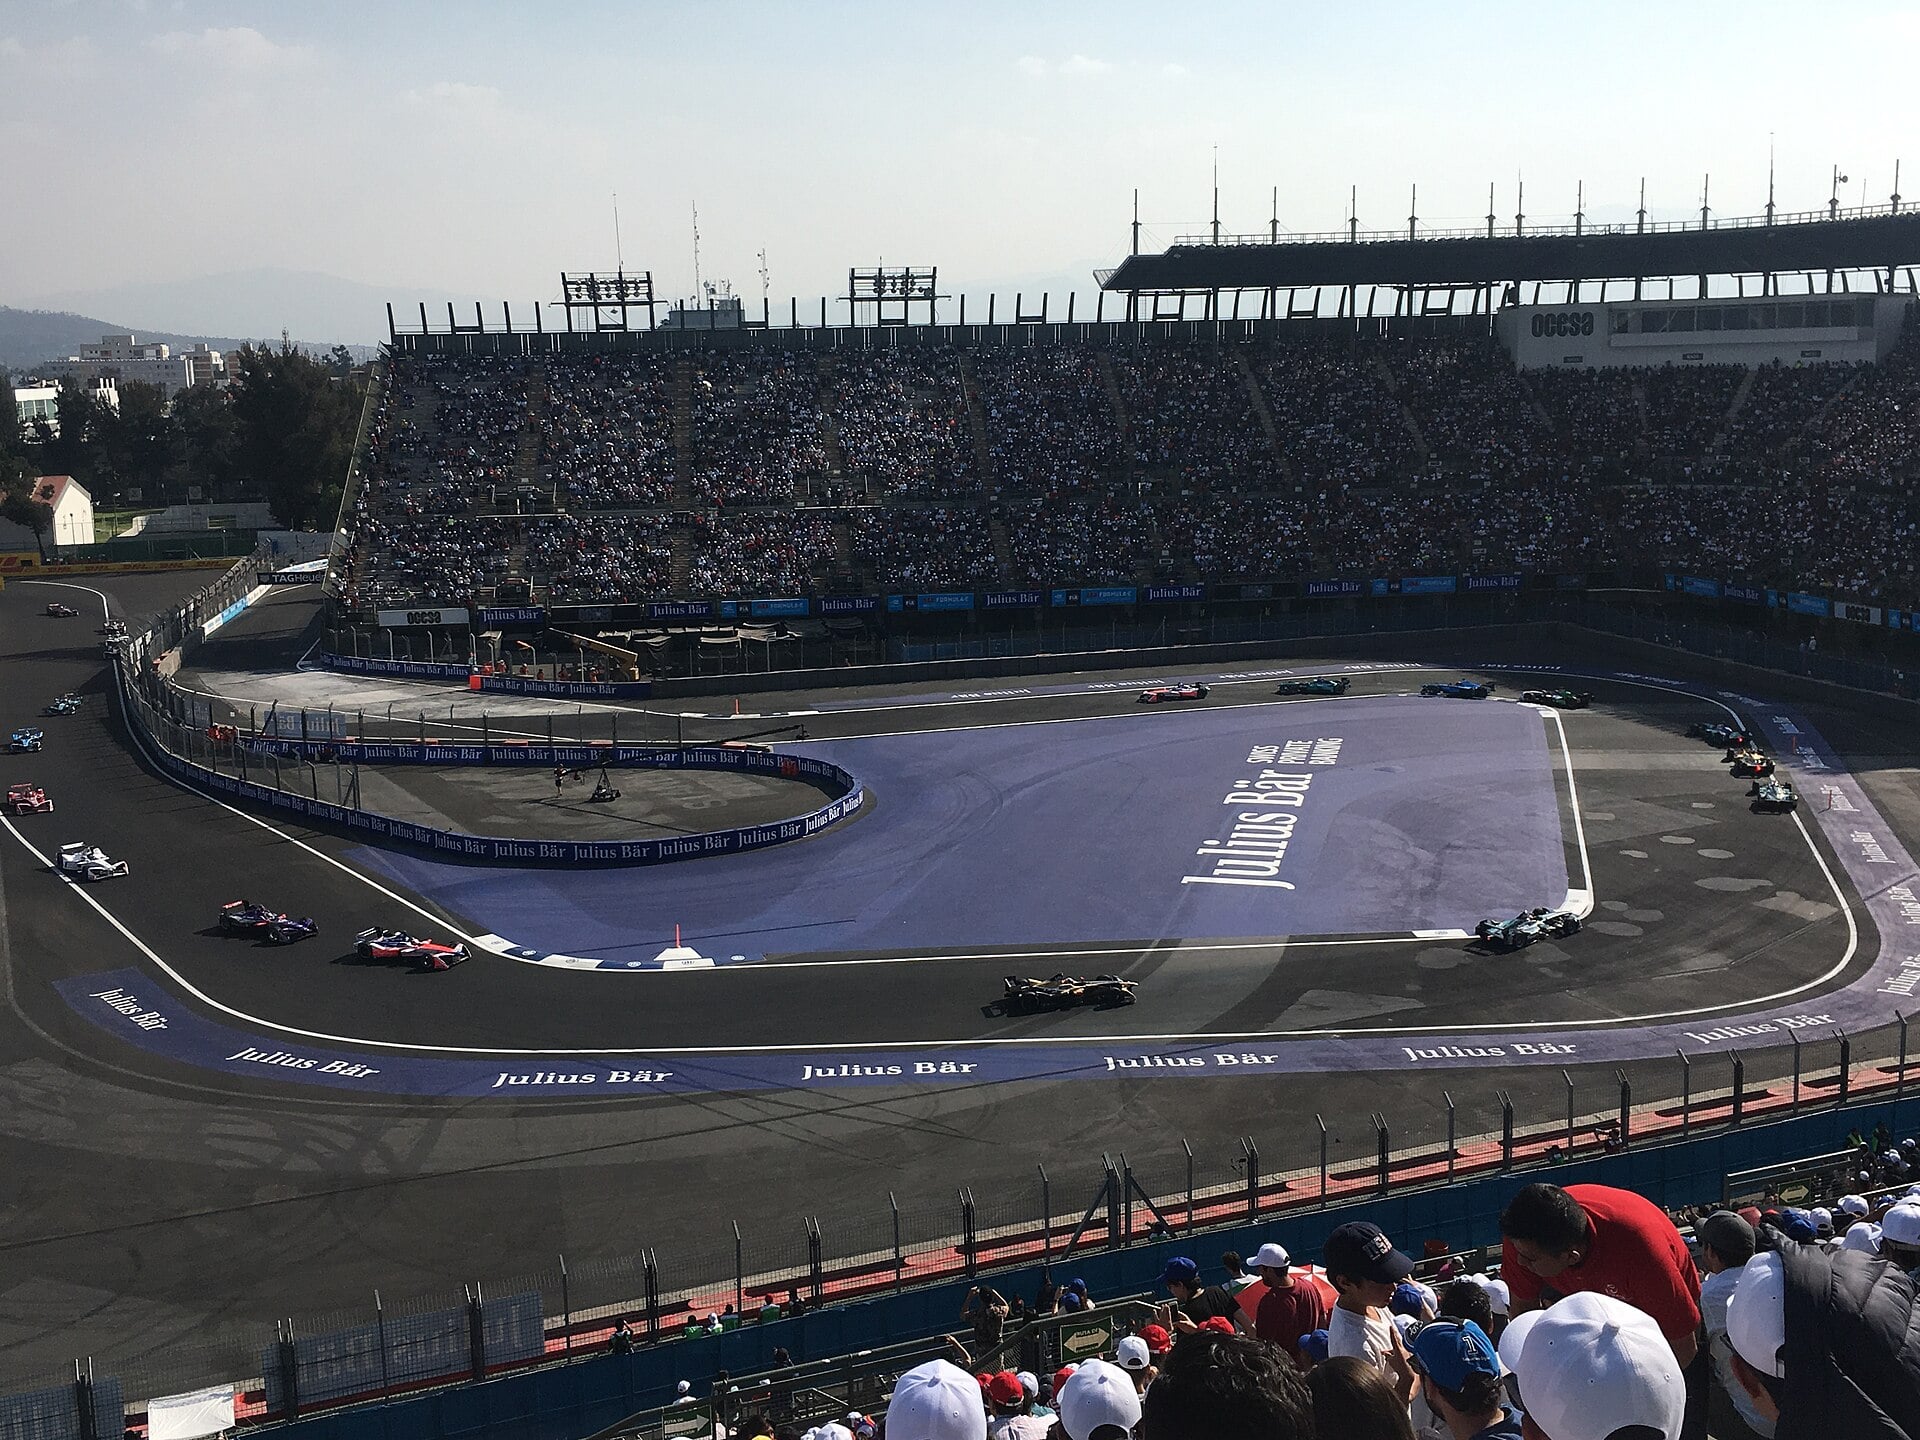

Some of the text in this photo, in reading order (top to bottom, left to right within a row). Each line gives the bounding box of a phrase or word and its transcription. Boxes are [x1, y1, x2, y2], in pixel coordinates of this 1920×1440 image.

[1309, 582, 1340, 594] Julius
[1342, 581, 1361, 593] Bär
[1468, 576, 1521, 589] Julius Bär
[986, 593, 1040, 606] Julius Bär
[1149, 587, 1202, 600] Julius Bär
[653, 605, 685, 616] Julius
[688, 603, 709, 615] Bär
[821, 599, 853, 611] Julius
[855, 598, 875, 610] Bär
[483, 608, 539, 622] Julius Bär
[365, 660, 386, 671] Julius
[404, 663, 442, 675] Julius Bär
[445, 666, 469, 677] Julius
[483, 678, 521, 690] Julius Bär
[524, 681, 566, 693] Julius Bär
[569, 683, 617, 695] Julius Bär
[339, 745, 359, 757] Bär
[364, 746, 419, 758] Julius Bär
[425, 748, 482, 760] Julius Bär
[492, 748, 550, 761] Julius Bär
[553, 749, 587, 761] Julius
[682, 751, 740, 765] Julius Bär
[1246, 745, 1280, 764] SWISS
[1277, 740, 1313, 765] PRIVATE
[1308, 737, 1344, 765] BANKING
[746, 752, 775, 767] Julius
[798, 757, 822, 773] Julius
[238, 784, 257, 800] Julius
[271, 792, 305, 811] Julius Bär
[307, 801, 345, 822] Julius Bär
[347, 809, 386, 832] Julius Bär
[805, 807, 841, 834] Julius Bär
[389, 821, 431, 844] Julius Bär
[738, 823, 801, 848] Julius Bär
[1181, 769, 1313, 890] Julius Bär
[434, 833, 487, 855] Julius Bär
[494, 842, 567, 859] Julius Bär
[658, 834, 730, 858] Julius Bär
[574, 845, 650, 861] Julius Bär
[1861, 843, 1897, 864] Julius
[89, 987, 168, 1031] Julius Bär
[1684, 1014, 1836, 1045] Julius Bär
[1402, 1042, 1577, 1062] Julius Bär
[226, 1047, 380, 1078] Julius Bär
[1103, 1052, 1279, 1071] Julius Bär
[800, 1060, 978, 1080] Julius Bär
[492, 1069, 674, 1088] Julius Bär
[1462, 1335, 1479, 1355] 1
